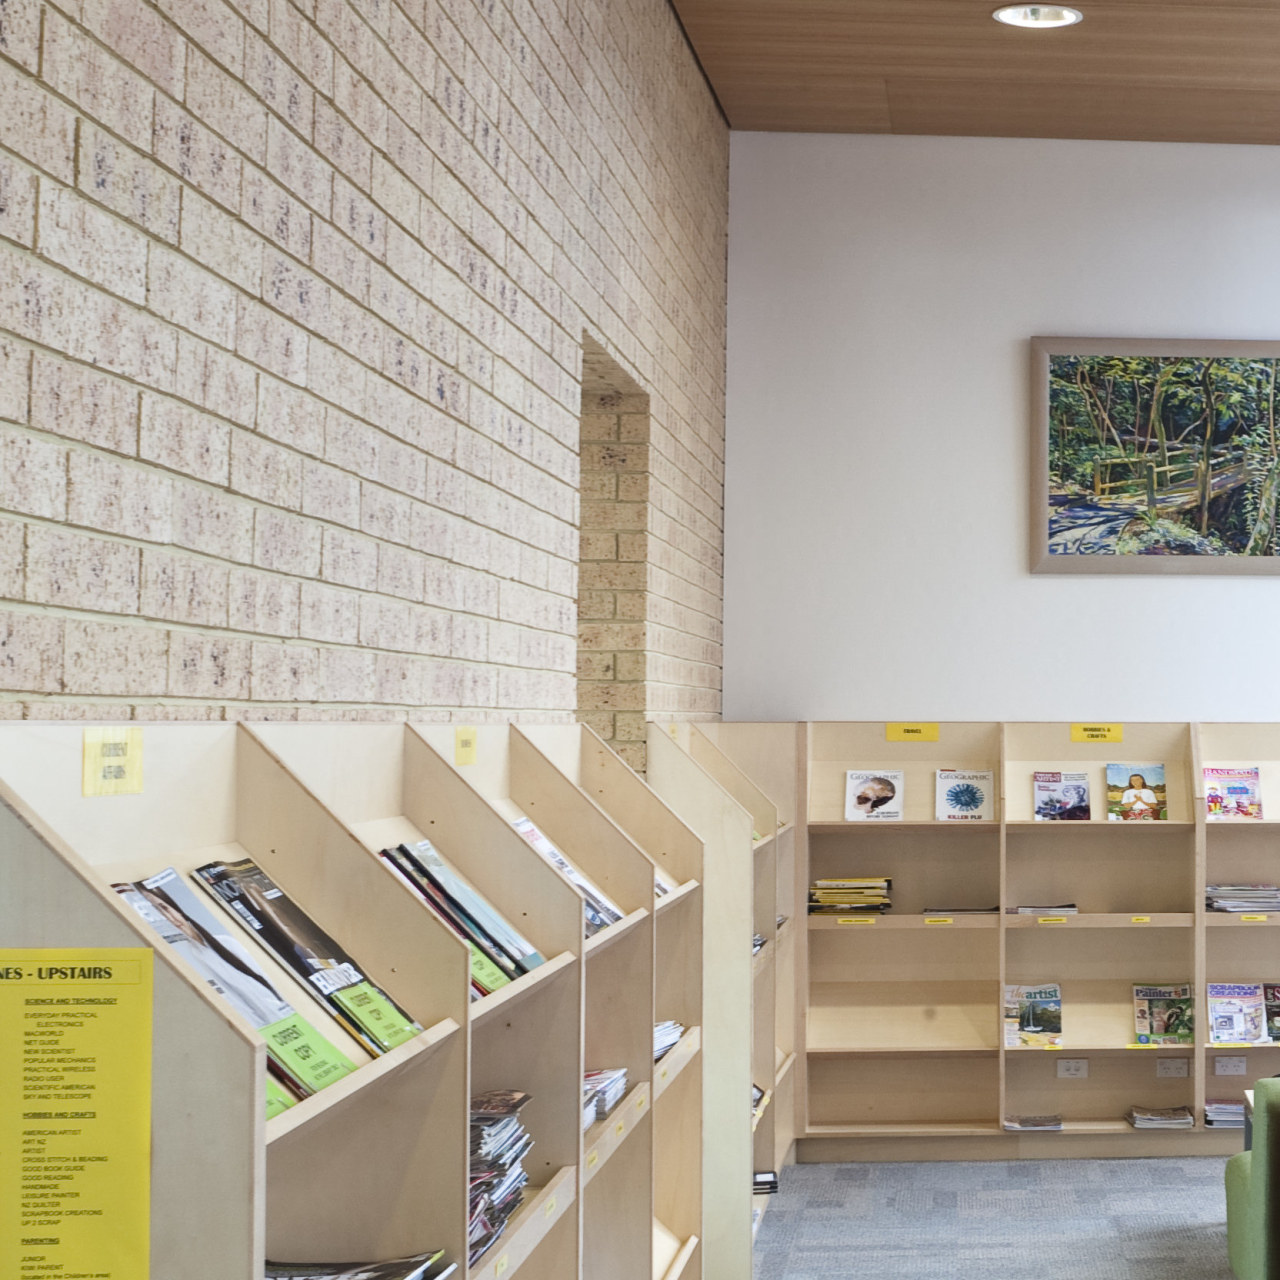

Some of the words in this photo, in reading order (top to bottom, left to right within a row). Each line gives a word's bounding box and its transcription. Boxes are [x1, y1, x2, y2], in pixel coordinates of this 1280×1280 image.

[939, 773, 991, 781] GEOGRAPHIC
[38, 967, 112, 979] UPSTAIRS
[1025, 988, 1059, 999] artist
[1135, 987, 1173, 997] Painter
